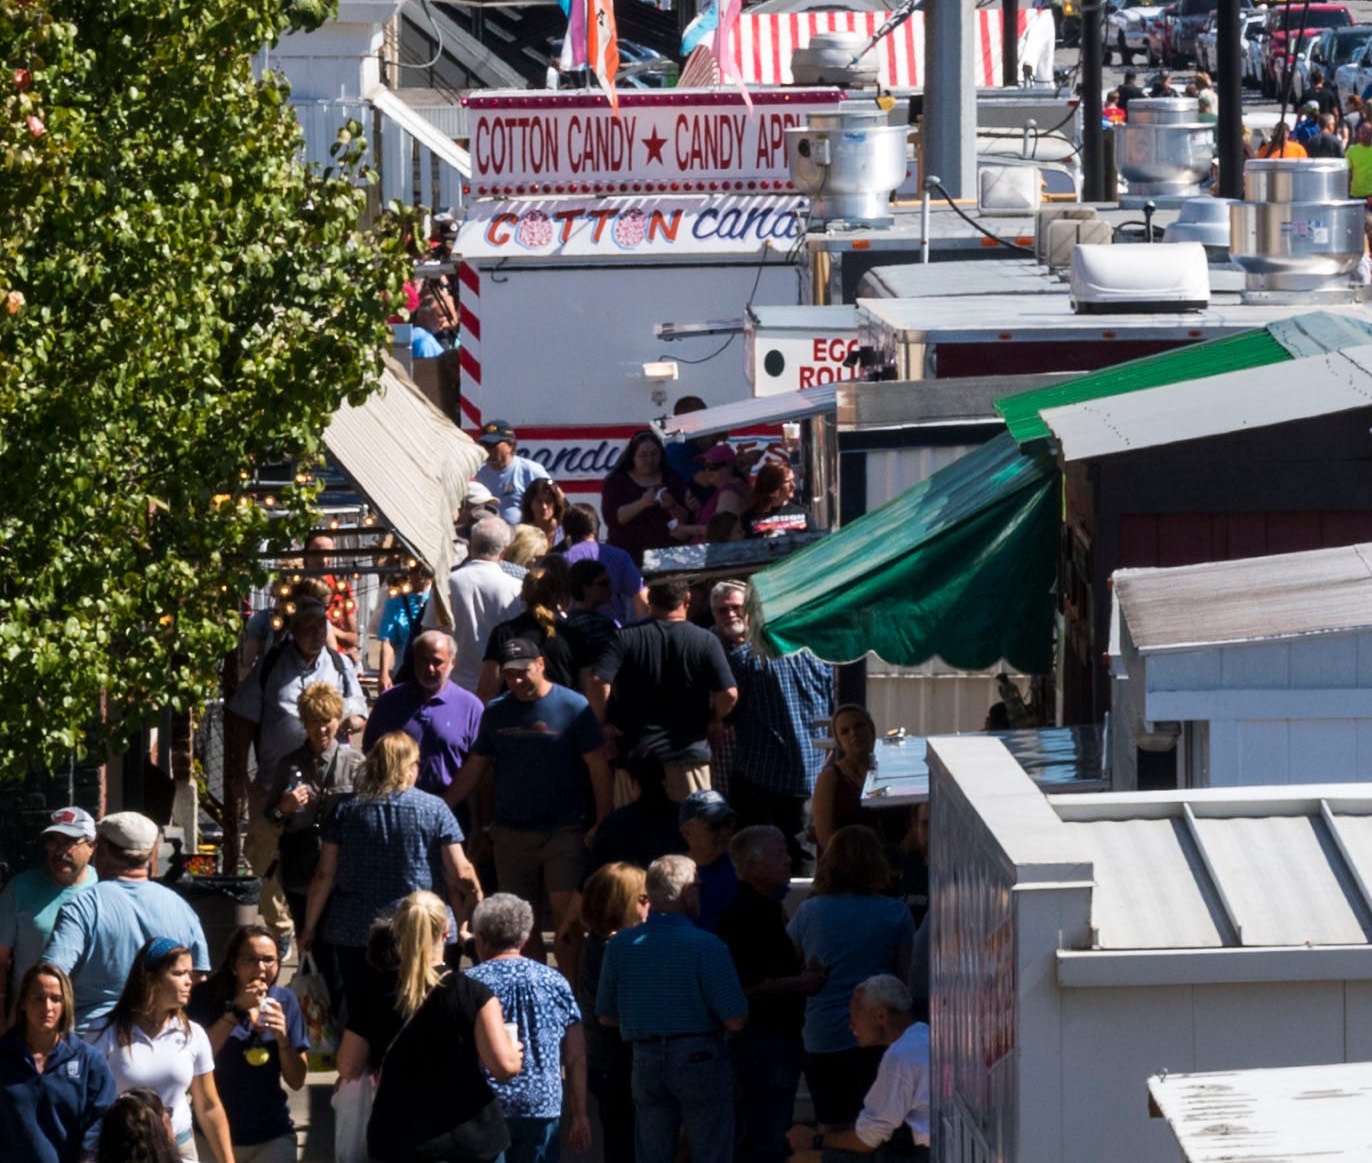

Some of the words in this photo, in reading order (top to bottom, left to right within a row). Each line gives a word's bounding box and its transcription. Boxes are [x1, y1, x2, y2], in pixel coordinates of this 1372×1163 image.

[476, 115, 559, 175] COTTON
[567, 114, 636, 175] CANDY
[675, 113, 747, 172] CANDY
[486, 208, 684, 248] COTTON
[693, 201, 805, 239] cand
